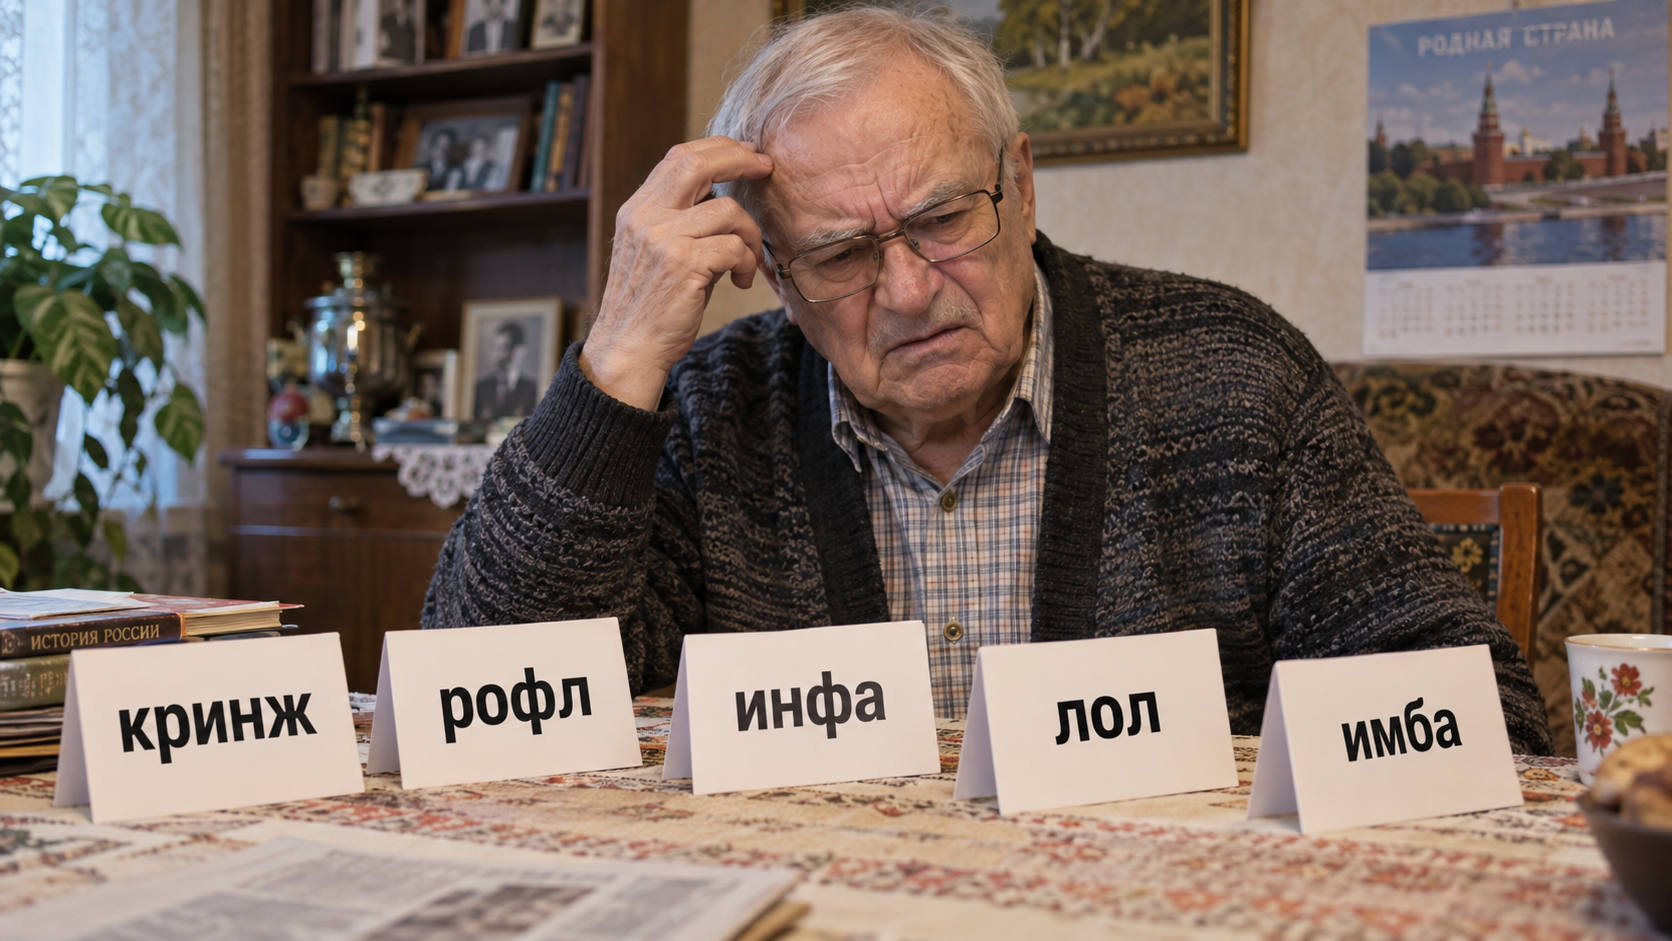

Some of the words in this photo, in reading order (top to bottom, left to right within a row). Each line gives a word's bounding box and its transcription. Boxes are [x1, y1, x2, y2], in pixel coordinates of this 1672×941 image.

[1418, 27, 1512, 57] РОДНАЯ
[1523, 17, 1615, 48] СТРАНА
[31, 629, 98, 651] ИСТОРИЯ
[104, 623, 161, 642] РОССИИ
[119, 693, 317, 764] кринж
[440, 667, 591, 743] рофл
[736, 671, 886, 739] инфа
[1056, 692, 1161, 745] лол
[1342, 697, 1462, 762] имба
